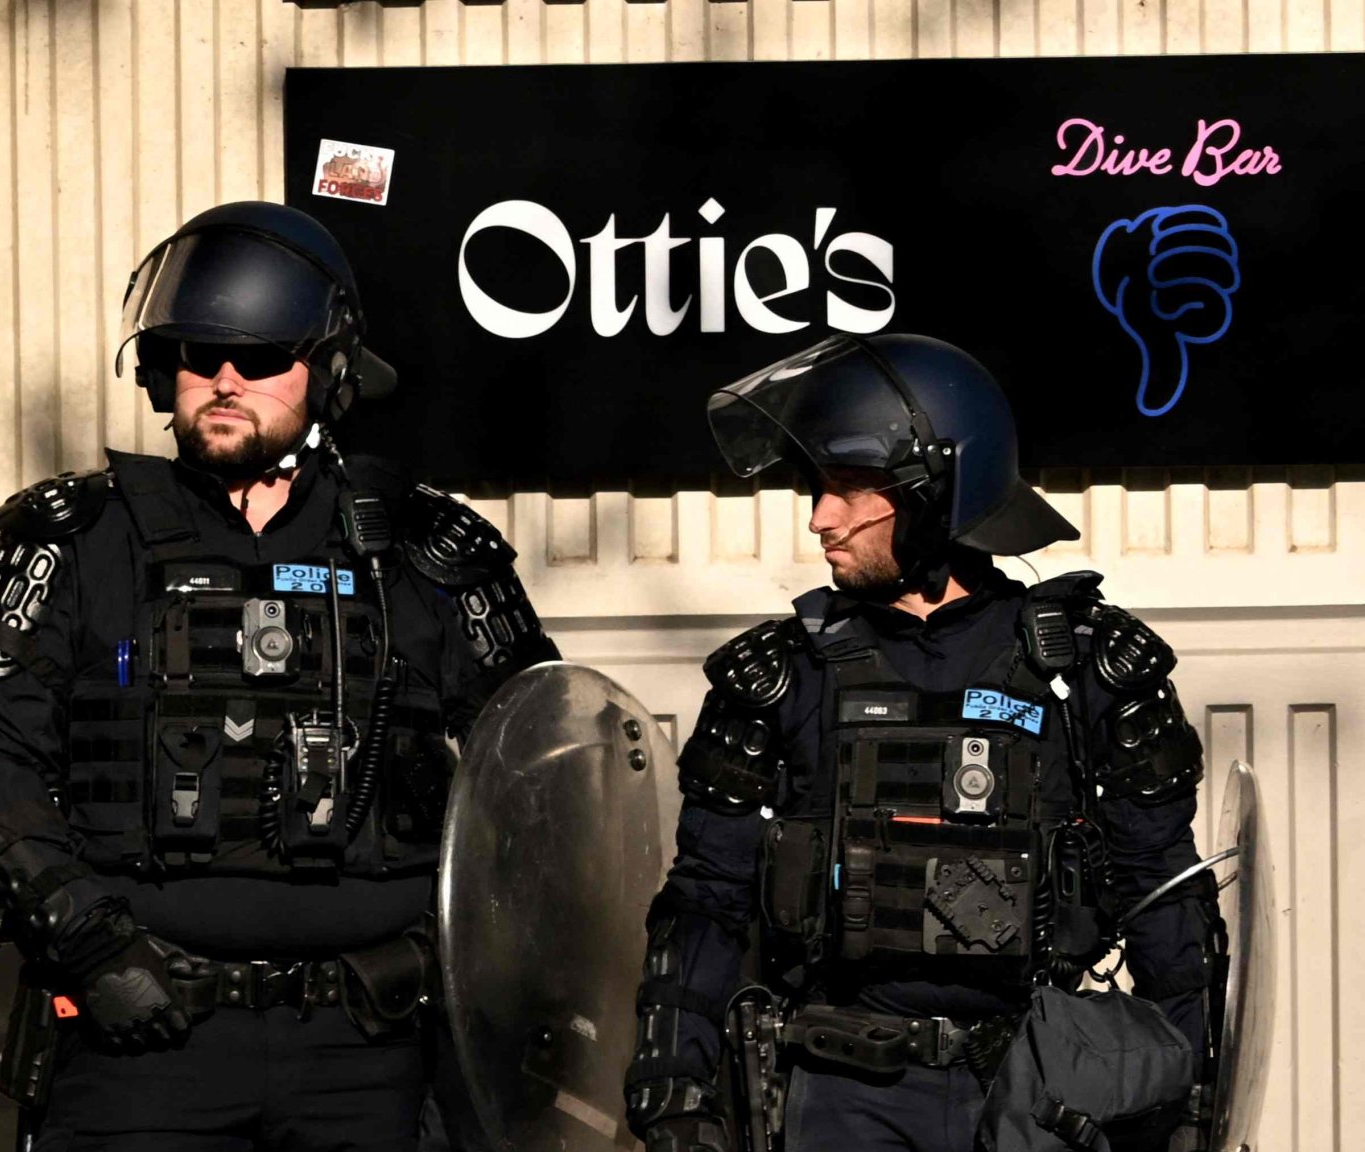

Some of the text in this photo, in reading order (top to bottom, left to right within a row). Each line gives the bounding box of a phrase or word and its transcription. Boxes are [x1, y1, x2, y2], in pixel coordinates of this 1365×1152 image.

[1052, 118, 1282, 187] Dive Bar
[318, 179, 383, 202] FORCES
[457, 197, 896, 339] Ottie's
[291, 582, 324, 592] 20
